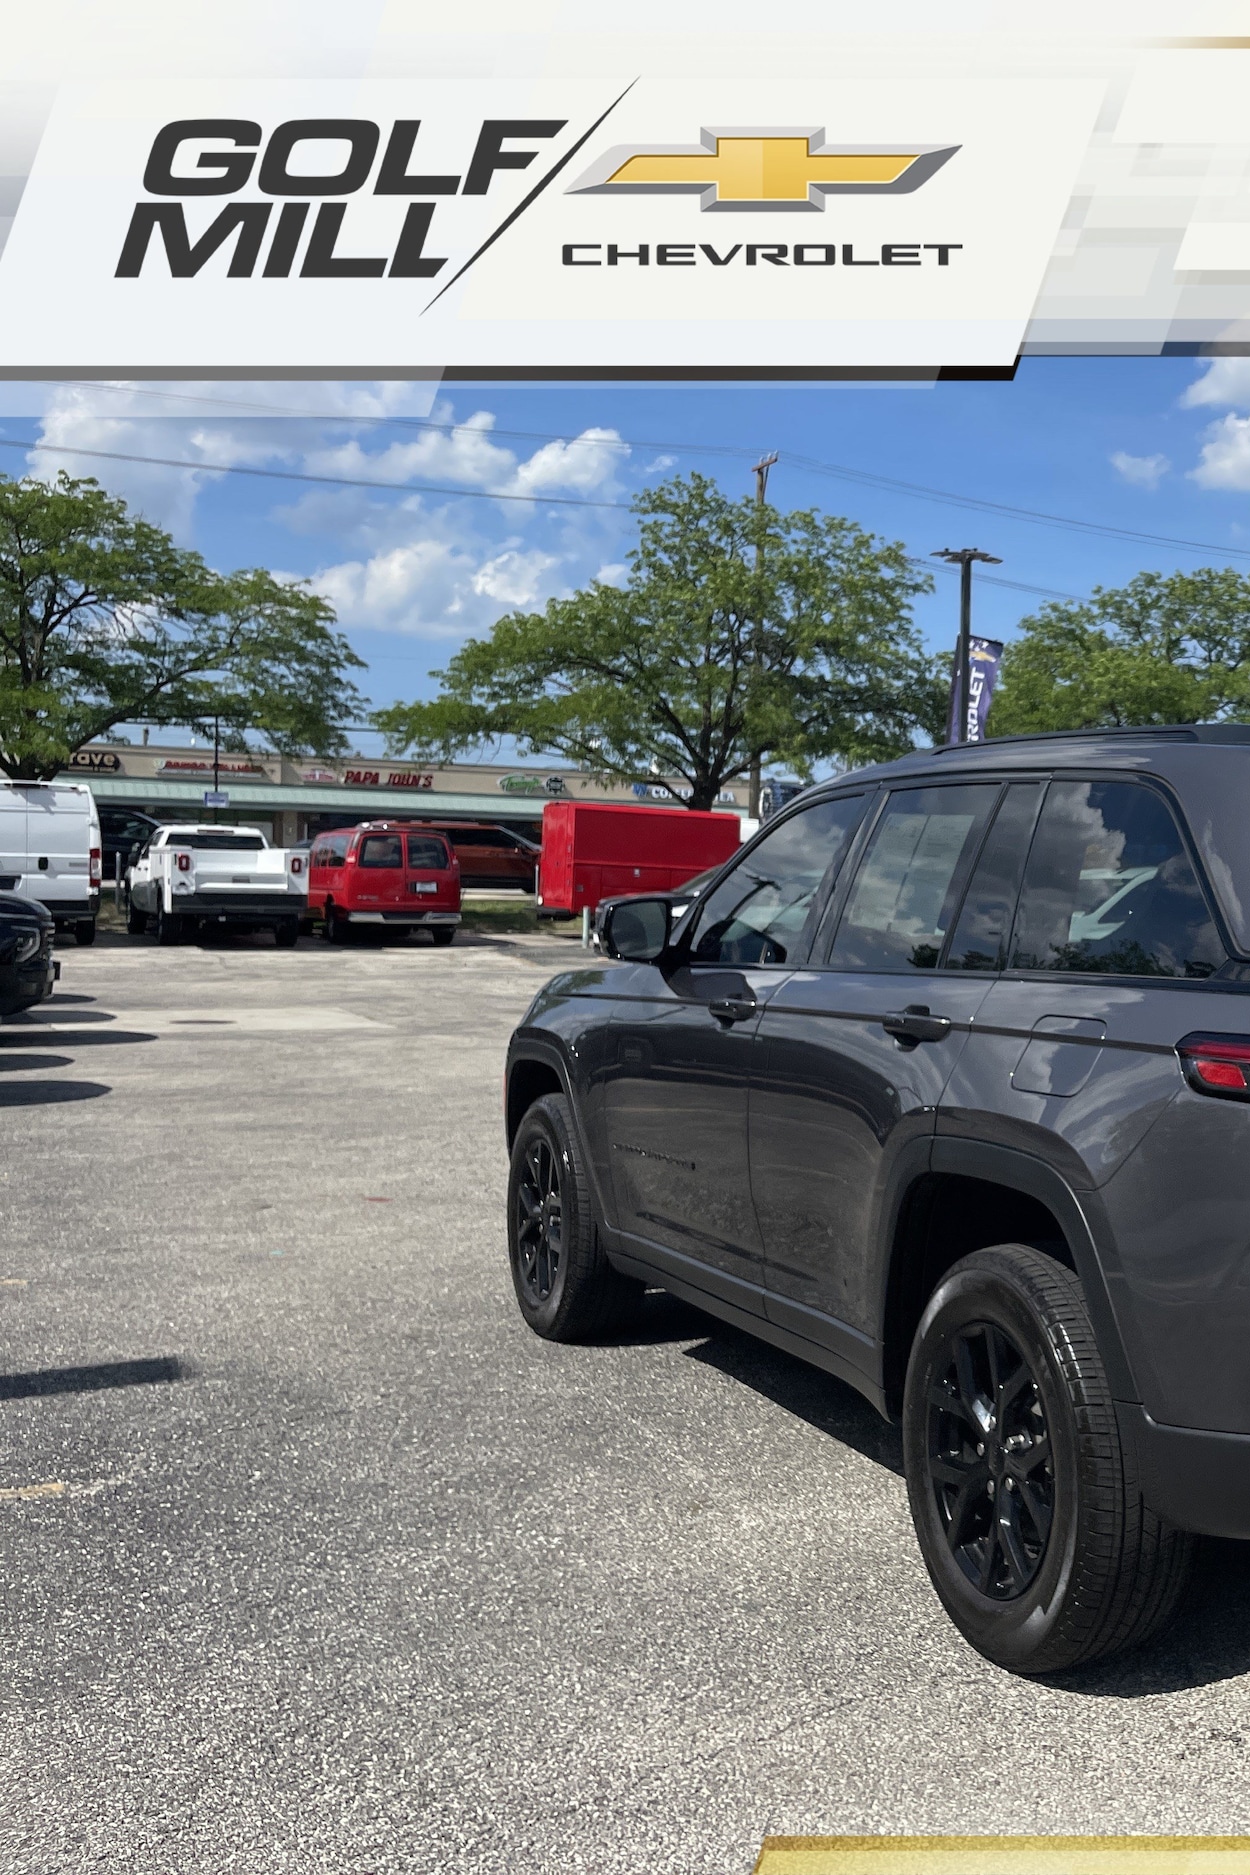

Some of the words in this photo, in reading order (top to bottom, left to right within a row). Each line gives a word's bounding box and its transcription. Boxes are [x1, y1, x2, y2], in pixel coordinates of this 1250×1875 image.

[966, 667, 985, 742] ROLET
[68, 752, 116, 766] rave
[344, 770, 380, 786] PAPA
